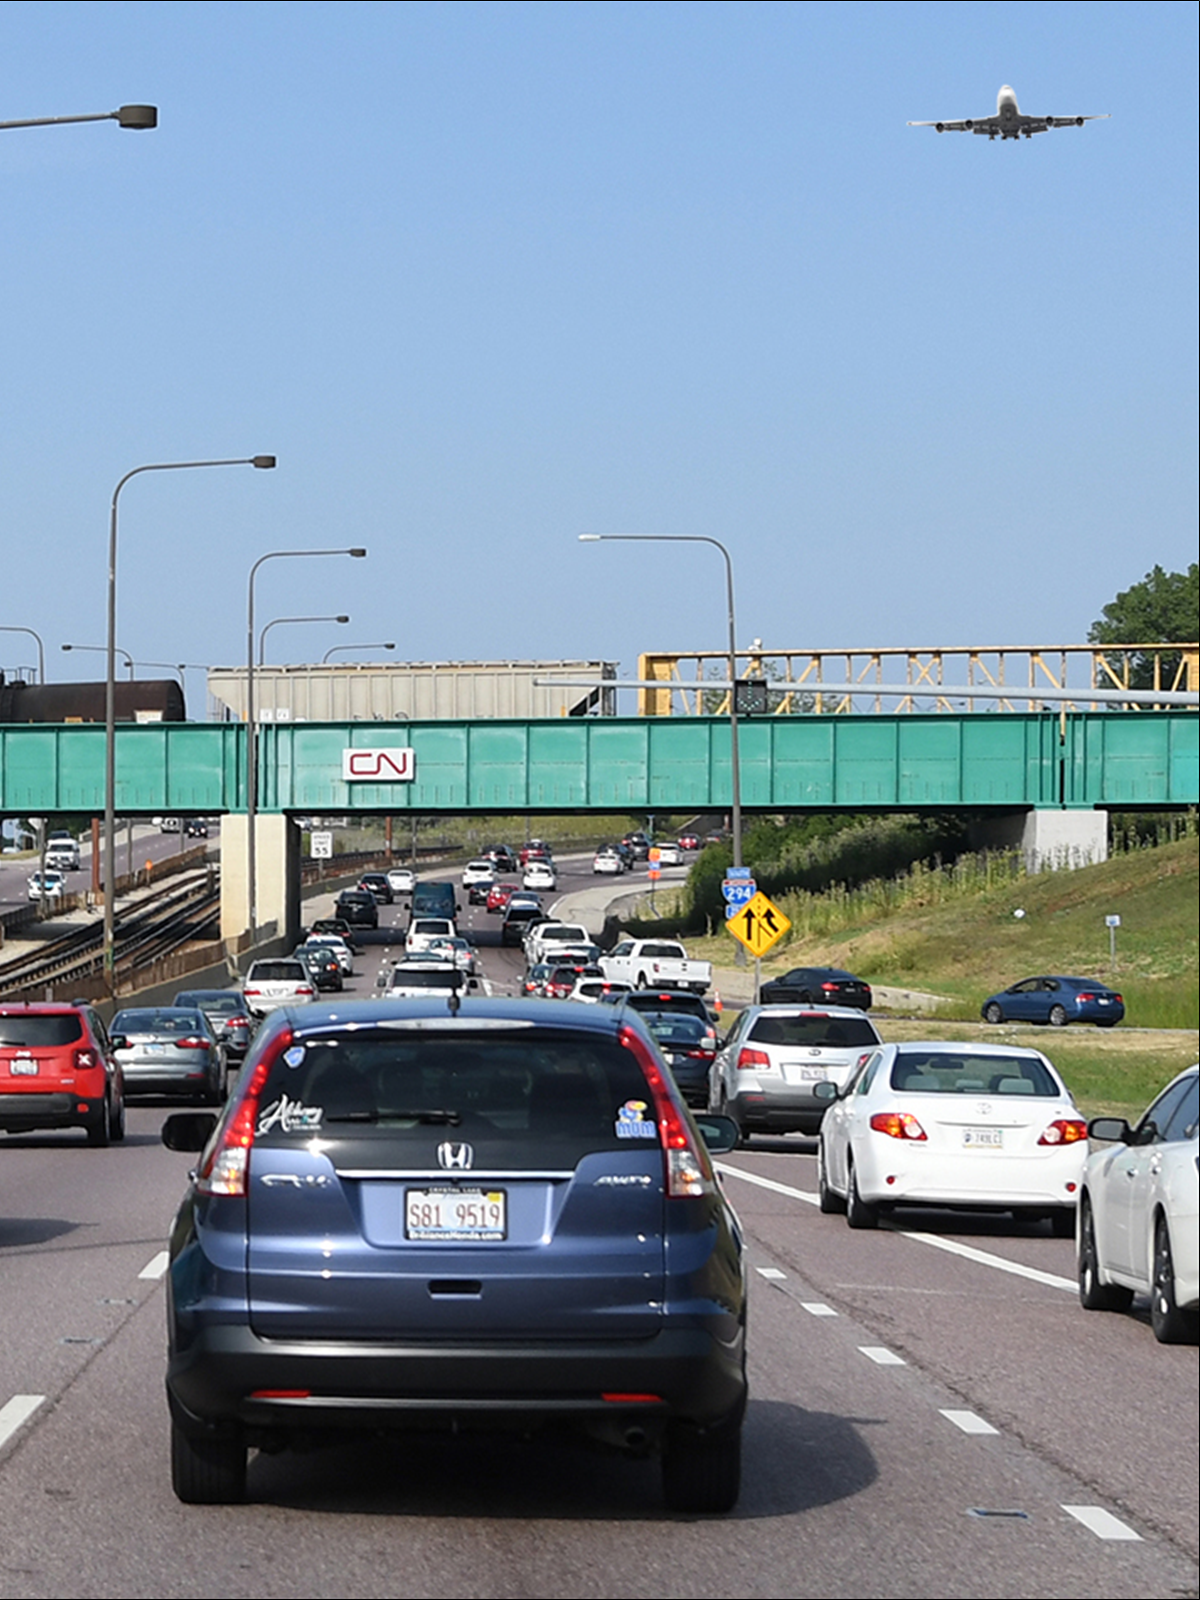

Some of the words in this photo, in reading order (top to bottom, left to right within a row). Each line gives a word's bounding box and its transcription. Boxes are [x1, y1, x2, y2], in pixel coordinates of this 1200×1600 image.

[350, 753, 407, 775] CN
[314, 847, 328, 856] 55
[726, 887, 751, 901] 294
[410, 1203, 442, 1229] S81
[455, 1203, 500, 1229] 9519
